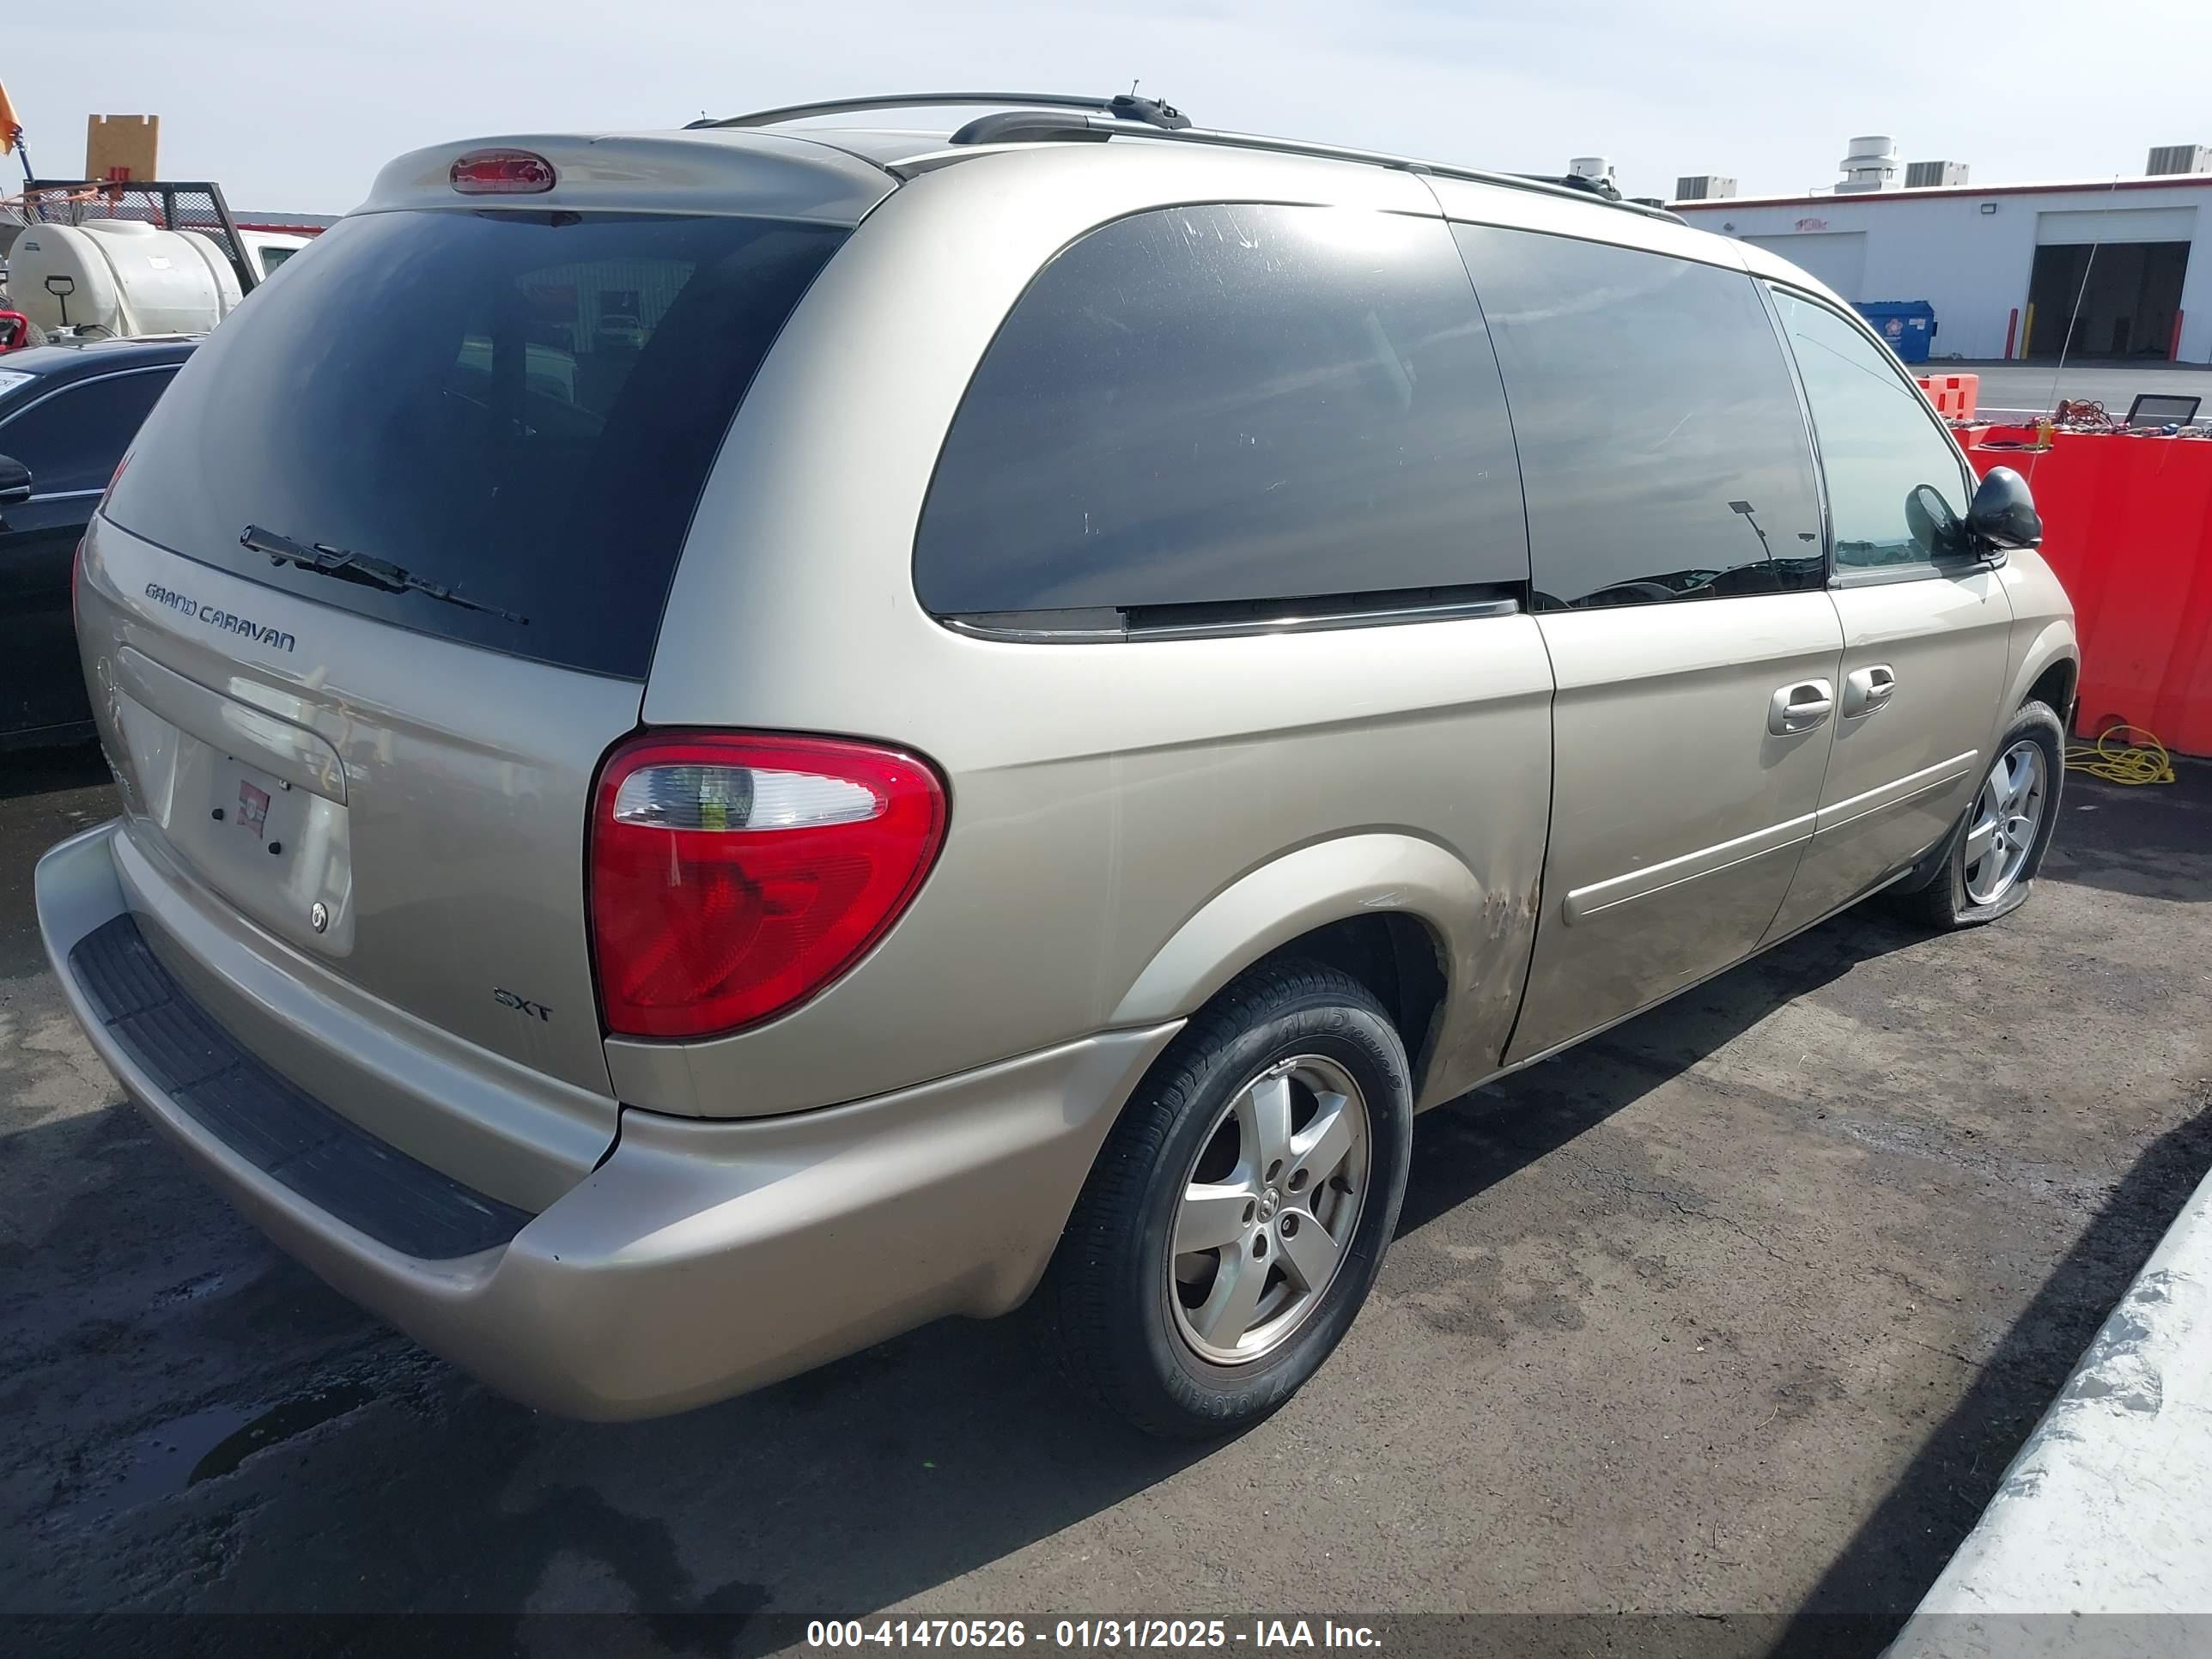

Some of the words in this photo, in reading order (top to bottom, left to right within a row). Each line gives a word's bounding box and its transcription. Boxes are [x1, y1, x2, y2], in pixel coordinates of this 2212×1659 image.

[144, 582, 198, 617] GRAND
[198, 605, 296, 653] CARAVAN
[493, 986, 554, 1023] SXT
